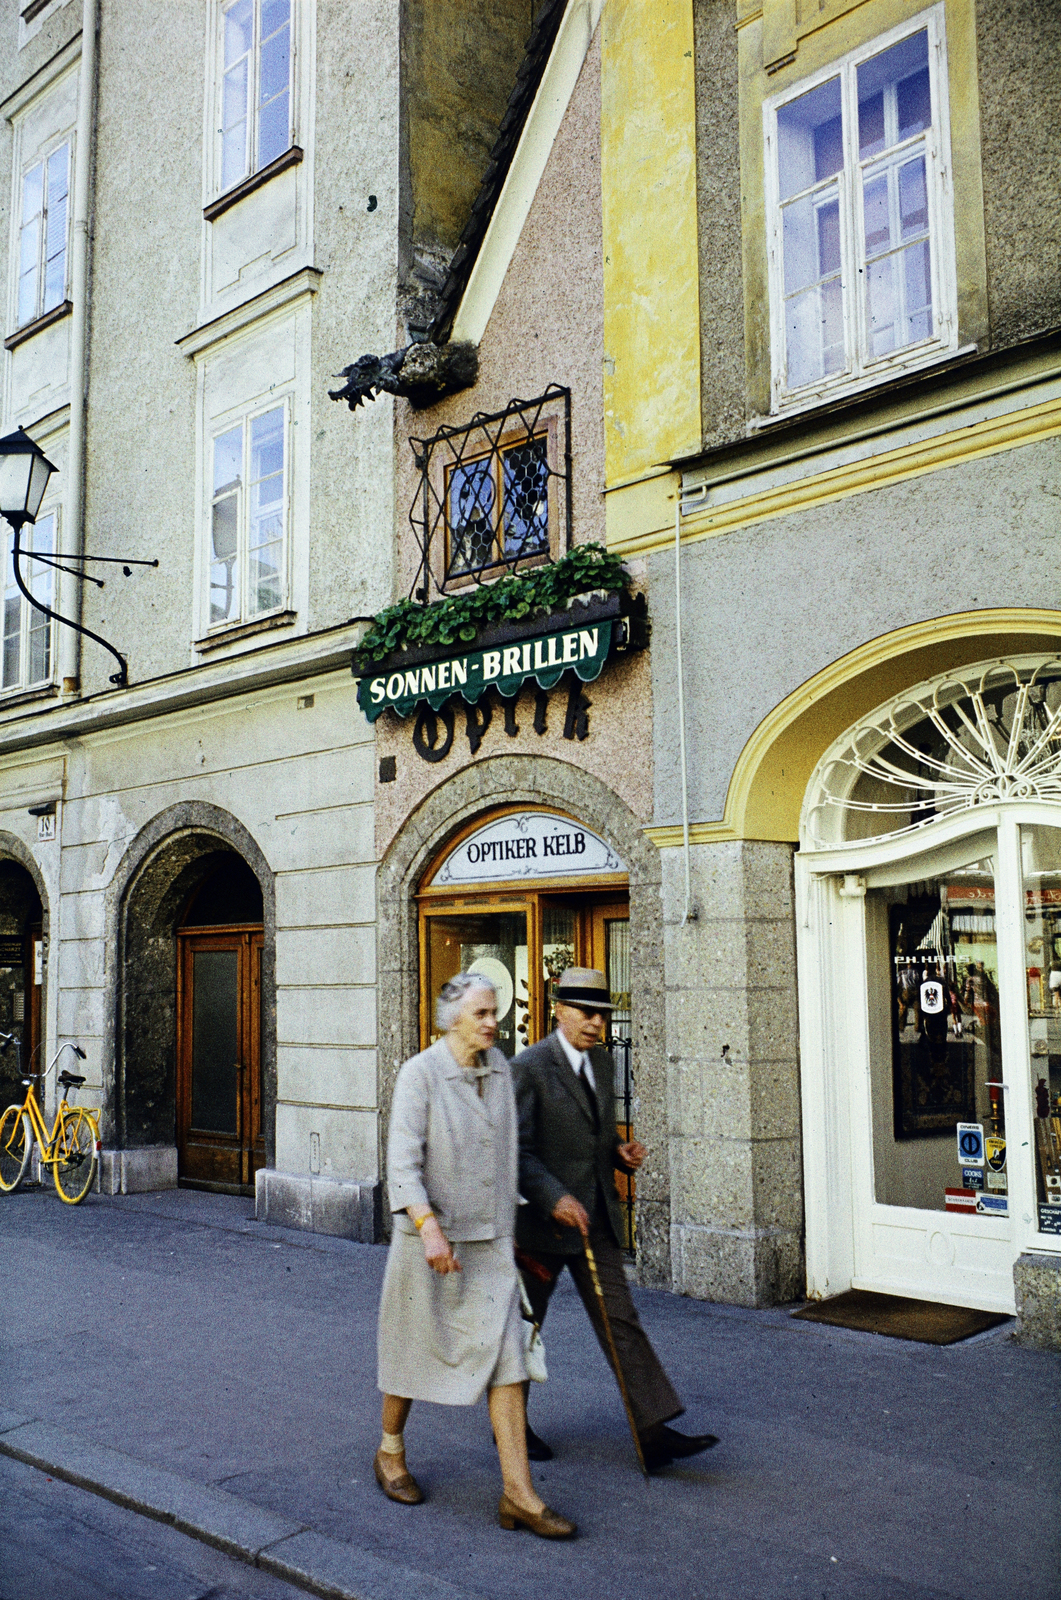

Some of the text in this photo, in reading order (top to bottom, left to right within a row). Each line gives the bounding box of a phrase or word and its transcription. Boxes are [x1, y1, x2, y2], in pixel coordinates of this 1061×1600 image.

[369, 628, 599, 704] SONNEN-BRILLEN
[467, 832, 586, 864] OPTIKER KELB
[921, 955, 970, 964] HAAS
[964, 1170, 982, 1178] COOKS
